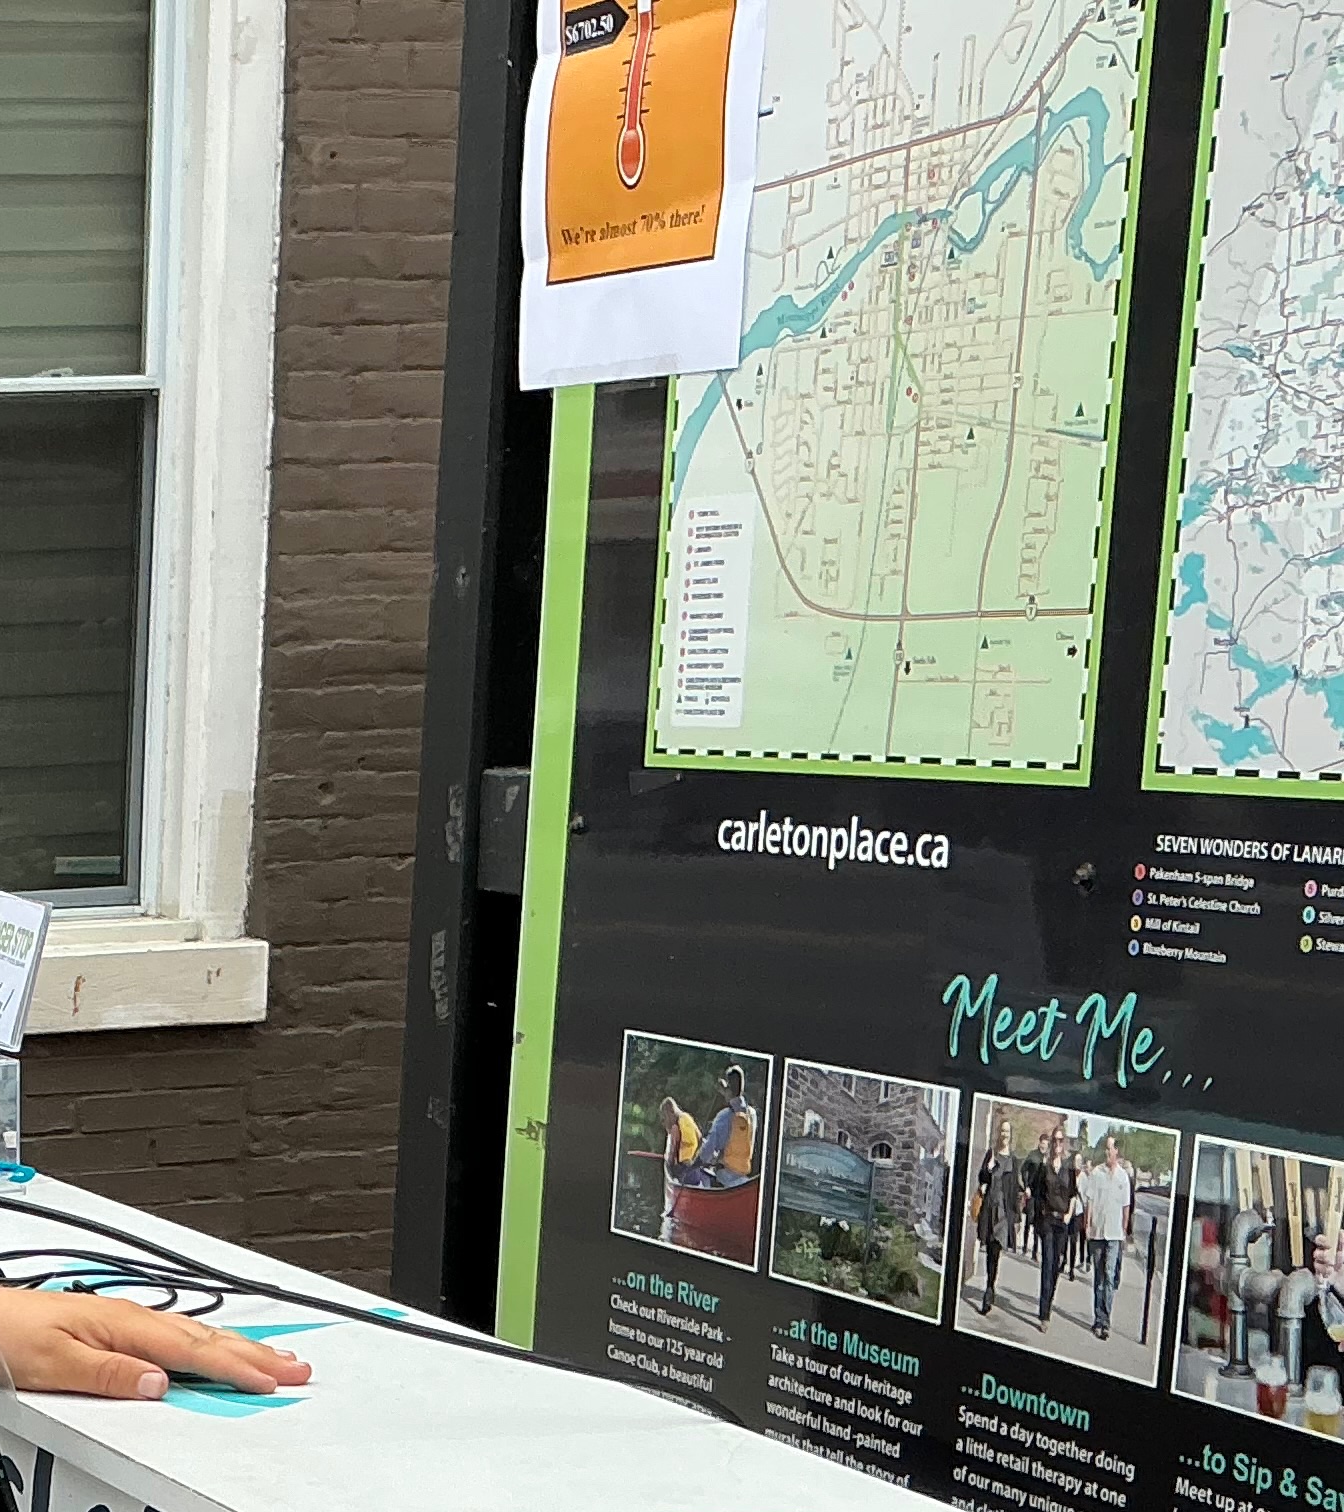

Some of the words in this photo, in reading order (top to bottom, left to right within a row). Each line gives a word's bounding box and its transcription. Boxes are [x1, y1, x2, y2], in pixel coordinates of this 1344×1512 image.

[561, 227, 596, 246] We're
[599, 220, 636, 241] almost
[640, 211, 666, 233] 70%
[669, 204, 706, 229] there!
[717, 809, 950, 871] carletonplace.ca
[1155, 834, 1198, 855] SEVEN
[1200, 838, 1269, 860] WONDERS
[1271, 843, 1292, 861] OF
[1149, 867, 1193, 882] Pakenham
[1225, 872, 1255, 891] Bridge
[1145, 918, 1161, 931] Mill
[1162, 919, 1171, 931] of
[1172, 921, 1201, 935] Kintail
[1159, 893, 1187, 909] Peter's
[1188, 897, 1227, 912] Celestine
[1229, 901, 1261, 915] Church
[1142, 942, 1183, 960] Blueberry
[1184, 948, 1227, 964] Mountain
[942, 973, 1067, 1065] Meet
[649, 1273, 674, 1299] the
[677, 1280, 721, 1313] River
[610, 1294, 639, 1316] Check
[639, 1305, 656, 1321] out
[656, 1308, 700, 1336] Riverside
[701, 1321, 725, 1343] Park
[608, 1317, 635, 1341] home
[636, 1328, 647, 1344] to
[647, 1334, 664, 1349] our
[665, 1338, 683, 1356] 125
[683, 1346, 706, 1365] year
[706, 1352, 724, 1369] old
[811, 1322, 838, 1350] the
[842, 1330, 921, 1377] Museum
[607, 1344, 636, 1367] Canoe
[661, 1365, 668, 1377] a
[669, 1364, 713, 1393] beautiful
[770, 1343, 795, 1367] Take
[796, 1356, 804, 1369] a
[805, 1355, 829, 1377] tour
[829, 1364, 843, 1380] of
[843, 1370, 864, 1389] our
[864, 1373, 913, 1407] heritage
[765, 1401, 821, 1432] wonderful
[822, 1417, 852, 1441] hand
[767, 1373, 833, 1407] architecture
[834, 1396, 856, 1415] and
[856, 1400, 883, 1424] look
[883, 1408, 901, 1429] for
[901, 1420, 923, 1437] our
[801, 1438, 827, 1458] that
[826, 1447, 844, 1464] tell
[844, 1454, 864, 1471] the
[896, 1473, 911, 1488] of
[957, 1405, 999, 1433] Spend
[999, 1421, 1008, 1436] a
[1009, 1423, 1035, 1448] day
[1035, 1431, 1094, 1465] together
[1094, 1450, 1136, 1483] doing
[952, 1465, 968, 1484] of
[968, 1472, 991, 1490] our
[991, 1479, 1027, 1507] many
[955, 1438, 964, 1452] a
[965, 1436, 994, 1463] little
[996, 1450, 1030, 1475] retail
[1031, 1461, 1083, 1496] therapy
[1084, 1479, 1098, 1499] at
[1099, 1486, 1127, 1508] one
[1175, 1476, 1213, 1505] Meet
[1232, 1453, 1272, 1495] Sip
[1279, 1467, 1298, 1499] &
